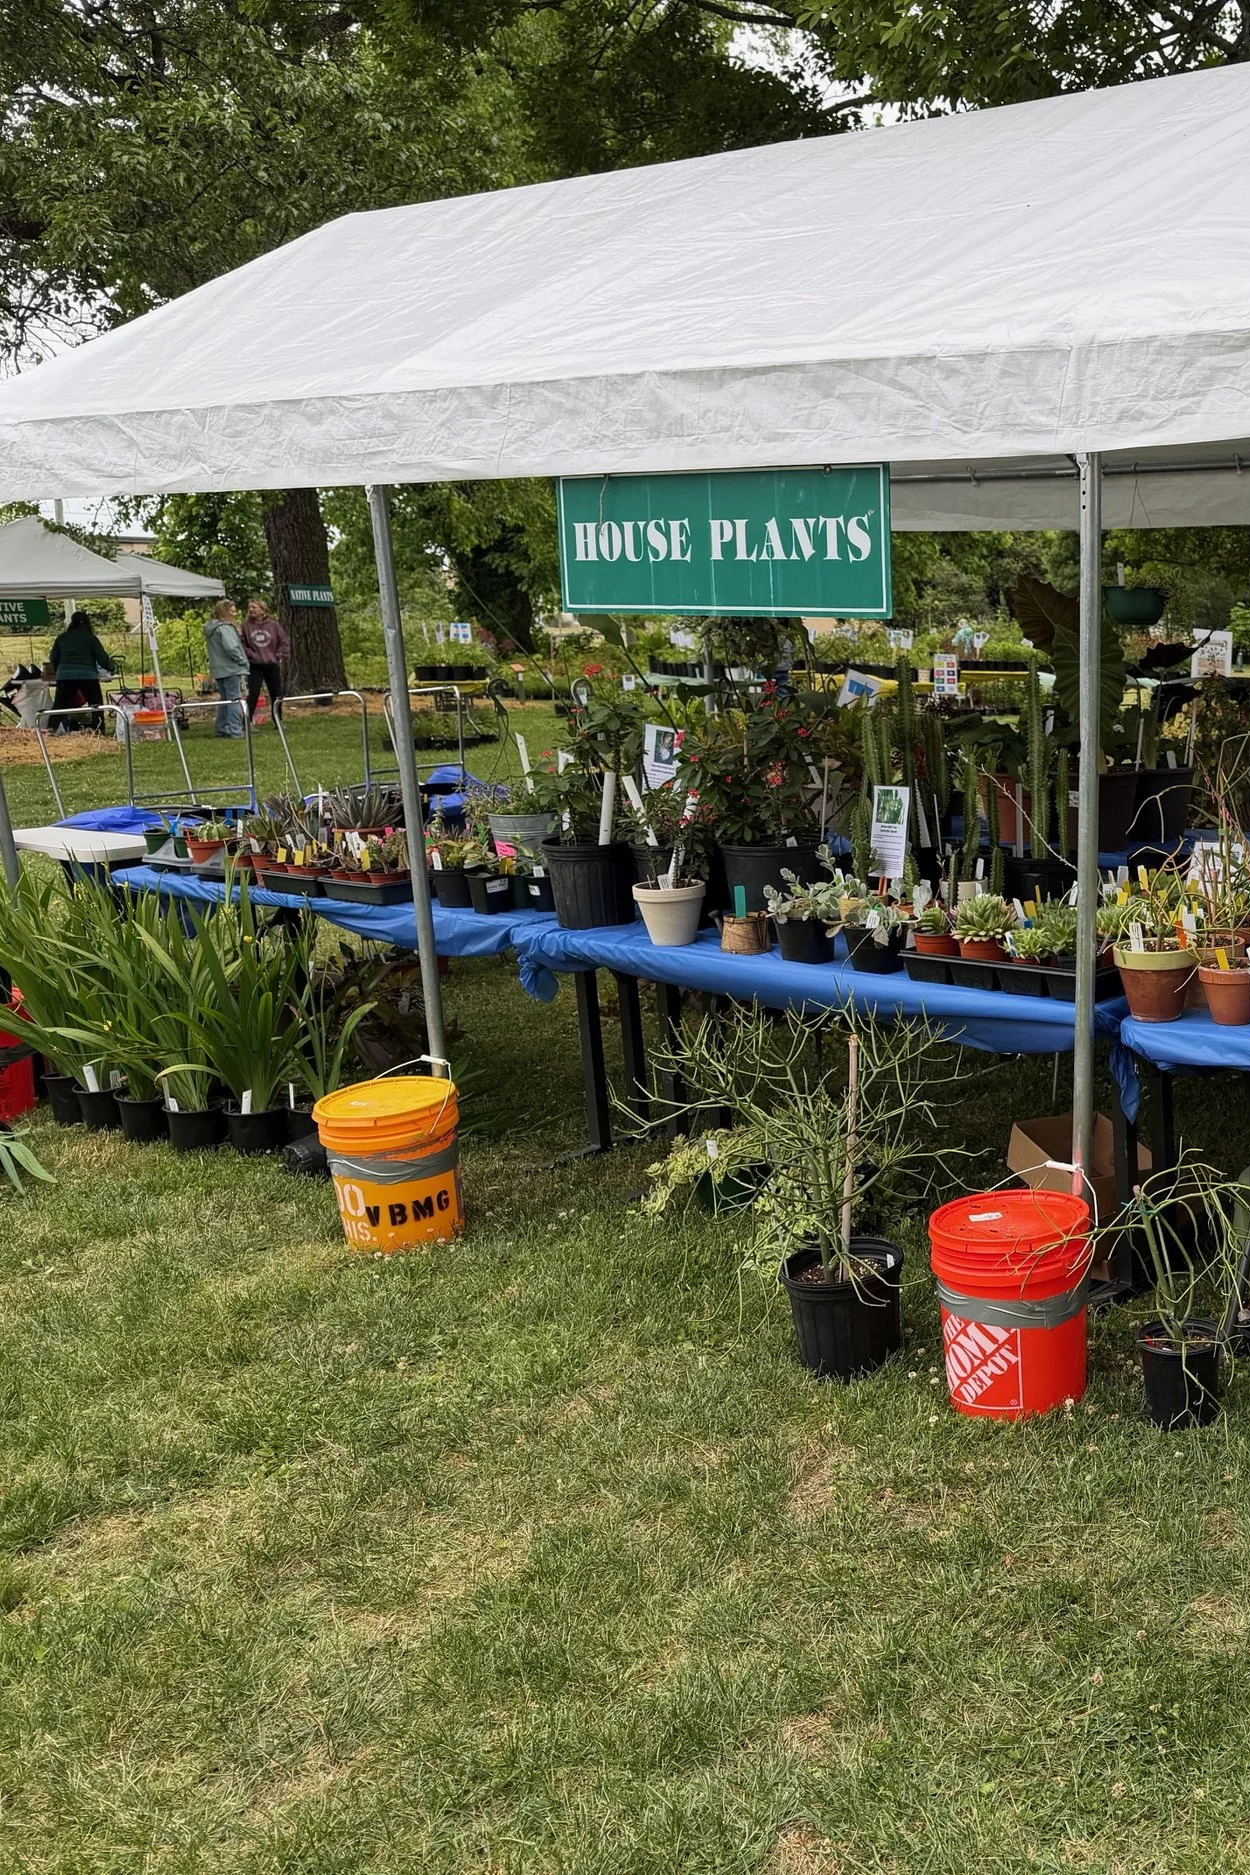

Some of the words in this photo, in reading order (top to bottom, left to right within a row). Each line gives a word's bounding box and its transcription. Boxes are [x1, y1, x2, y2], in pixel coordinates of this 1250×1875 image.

[573, 517, 693, 563] HOUSE
[709, 515, 873, 563] PLANTS
[959, 1344, 1019, 1404] DEPOT
